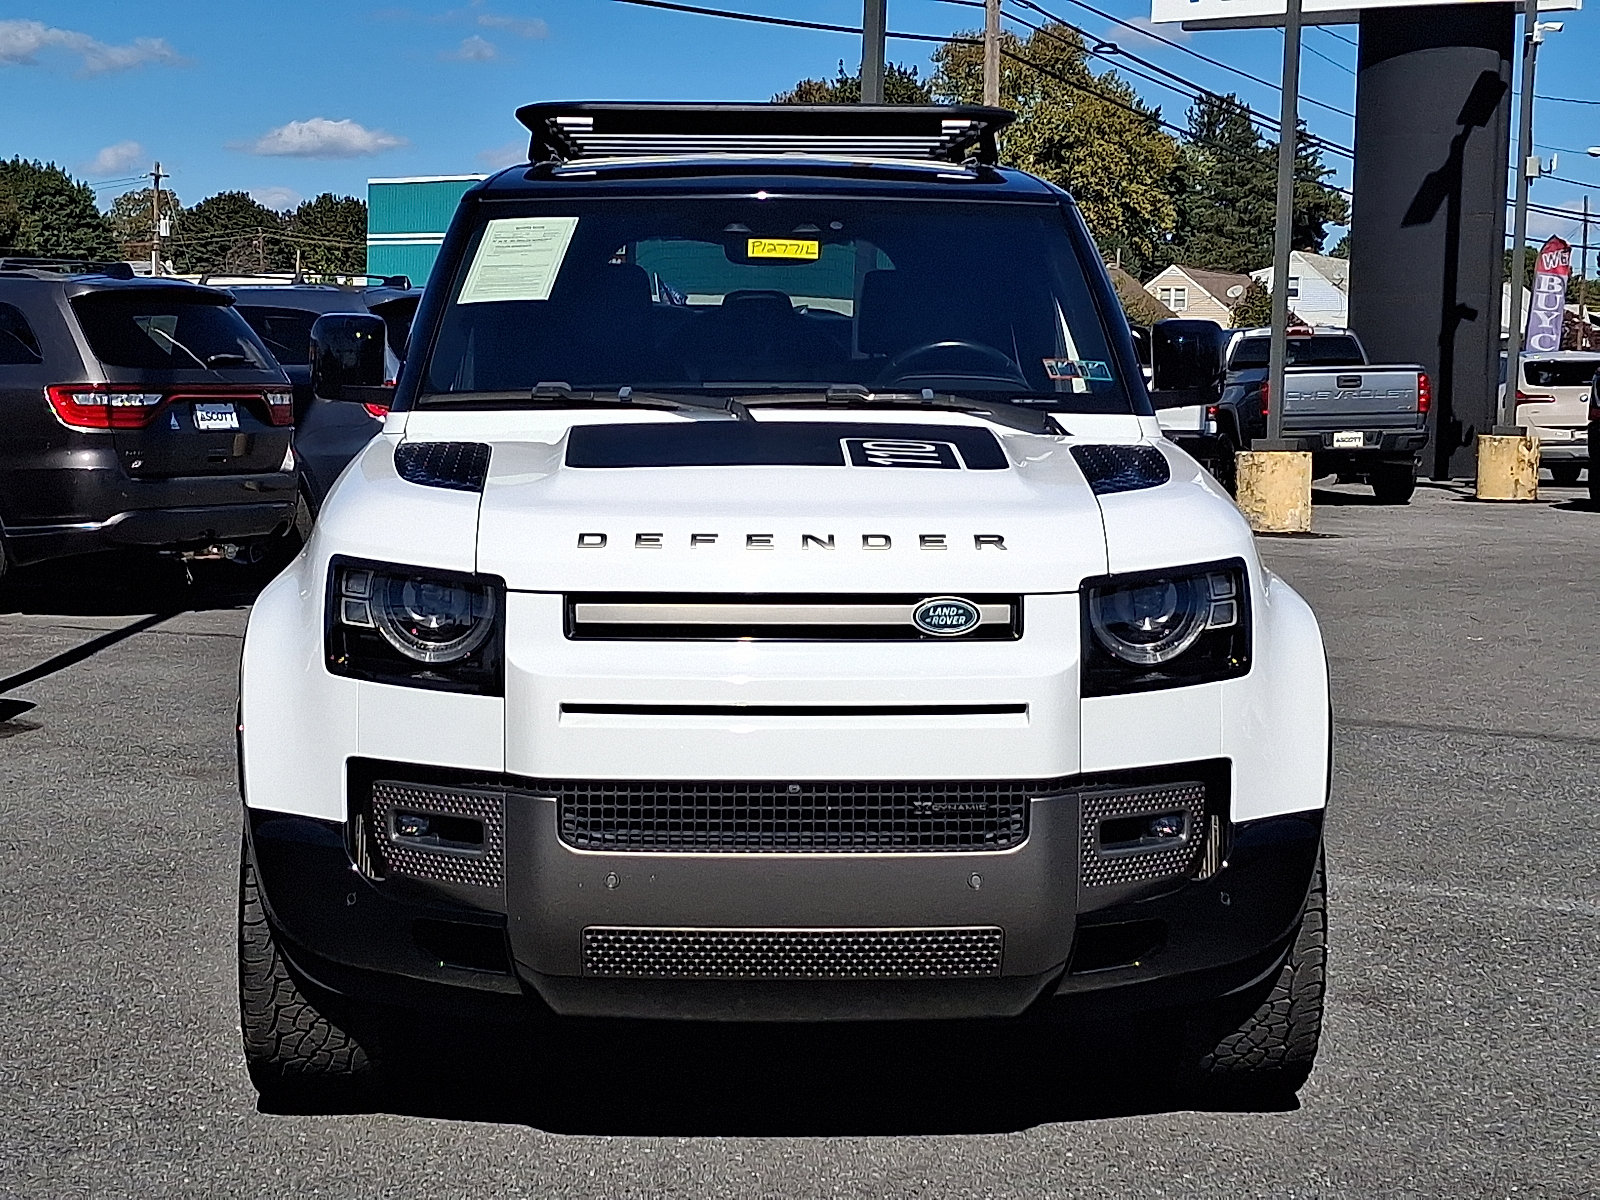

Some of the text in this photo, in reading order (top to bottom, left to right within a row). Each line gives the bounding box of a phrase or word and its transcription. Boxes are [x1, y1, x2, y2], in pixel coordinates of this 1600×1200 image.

[1533, 275, 1563, 328] BUY
[1285, 388, 1415, 401] CHEVROLET
[577, 532, 1008, 551] DEFENDER
[929, 606, 957, 616] LAND
[931, 615, 966, 625] ROVER
